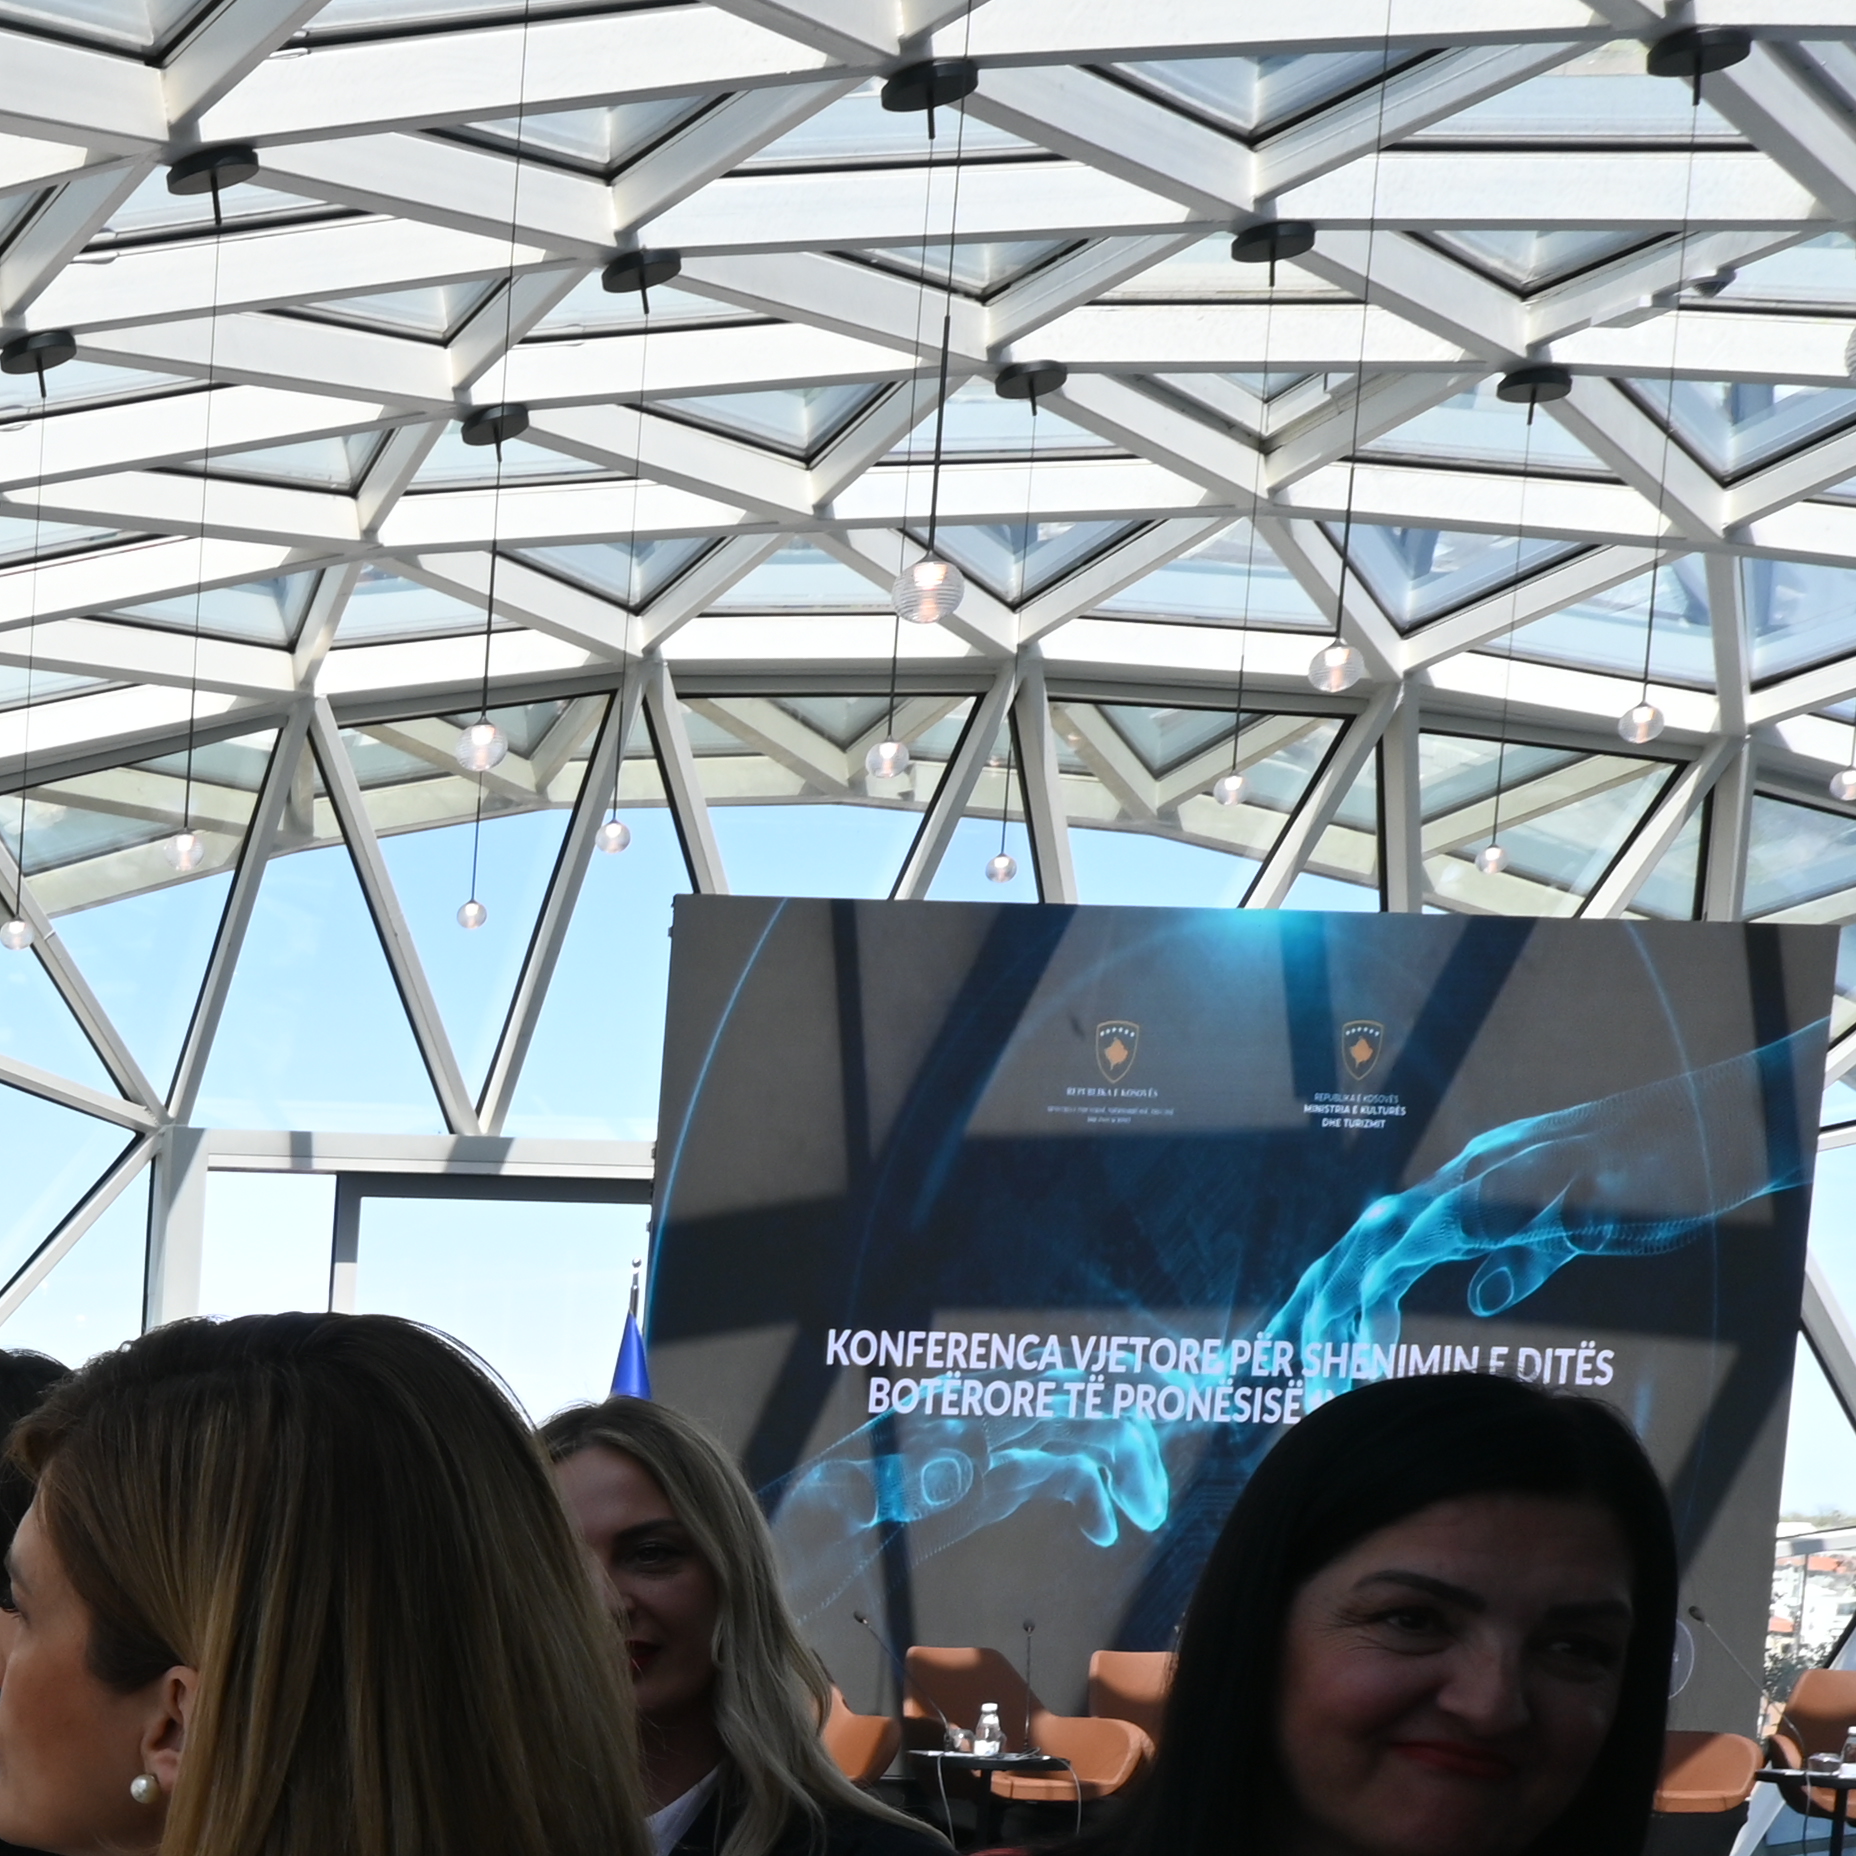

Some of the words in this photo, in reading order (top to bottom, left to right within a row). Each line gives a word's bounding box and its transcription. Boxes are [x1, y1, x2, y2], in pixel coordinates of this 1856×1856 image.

[1303, 1104, 1350, 1114] MINISTRIA
[1360, 1104, 1406, 1116] KULTURËS
[1321, 1118, 1341, 1128] DHE
[1343, 1118, 1386, 1129] TURIZMIT
[825, 1328, 1064, 1371] KONFERENCA
[1071, 1335, 1223, 1375] VJETORE
[1231, 1331, 1295, 1378] PËR
[1301, 1341, 1480, 1380] SHENIMIN
[1516, 1340, 1616, 1387] DITËS
[868, 1371, 1055, 1418] BOTËRORE
[1064, 1374, 1103, 1420] TË
[1113, 1377, 1304, 1425] PRONËSISË
